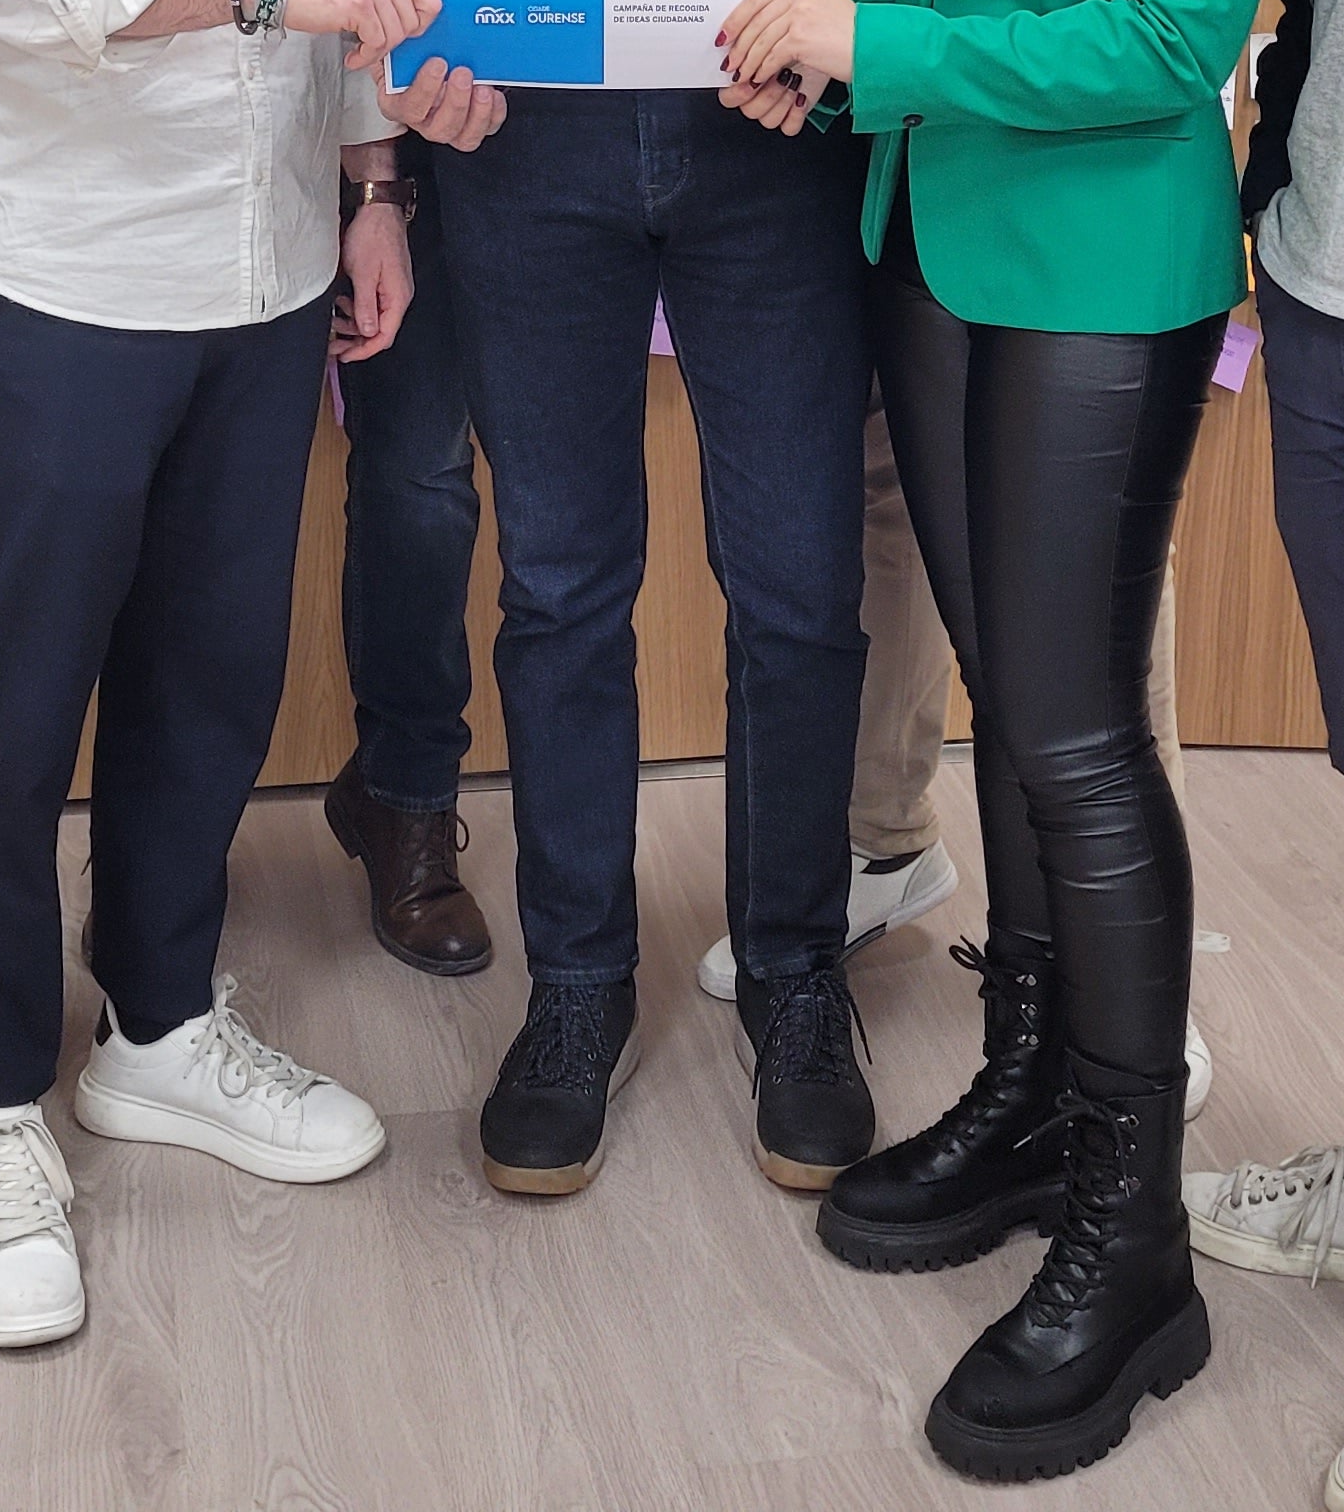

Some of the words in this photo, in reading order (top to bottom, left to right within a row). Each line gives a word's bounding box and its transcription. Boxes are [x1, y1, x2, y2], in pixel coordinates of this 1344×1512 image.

[613, 4, 654, 12] CAMPAÑA
[668, 4, 710, 12] RECOGIDA
[528, 13, 585, 24] OURENSE
